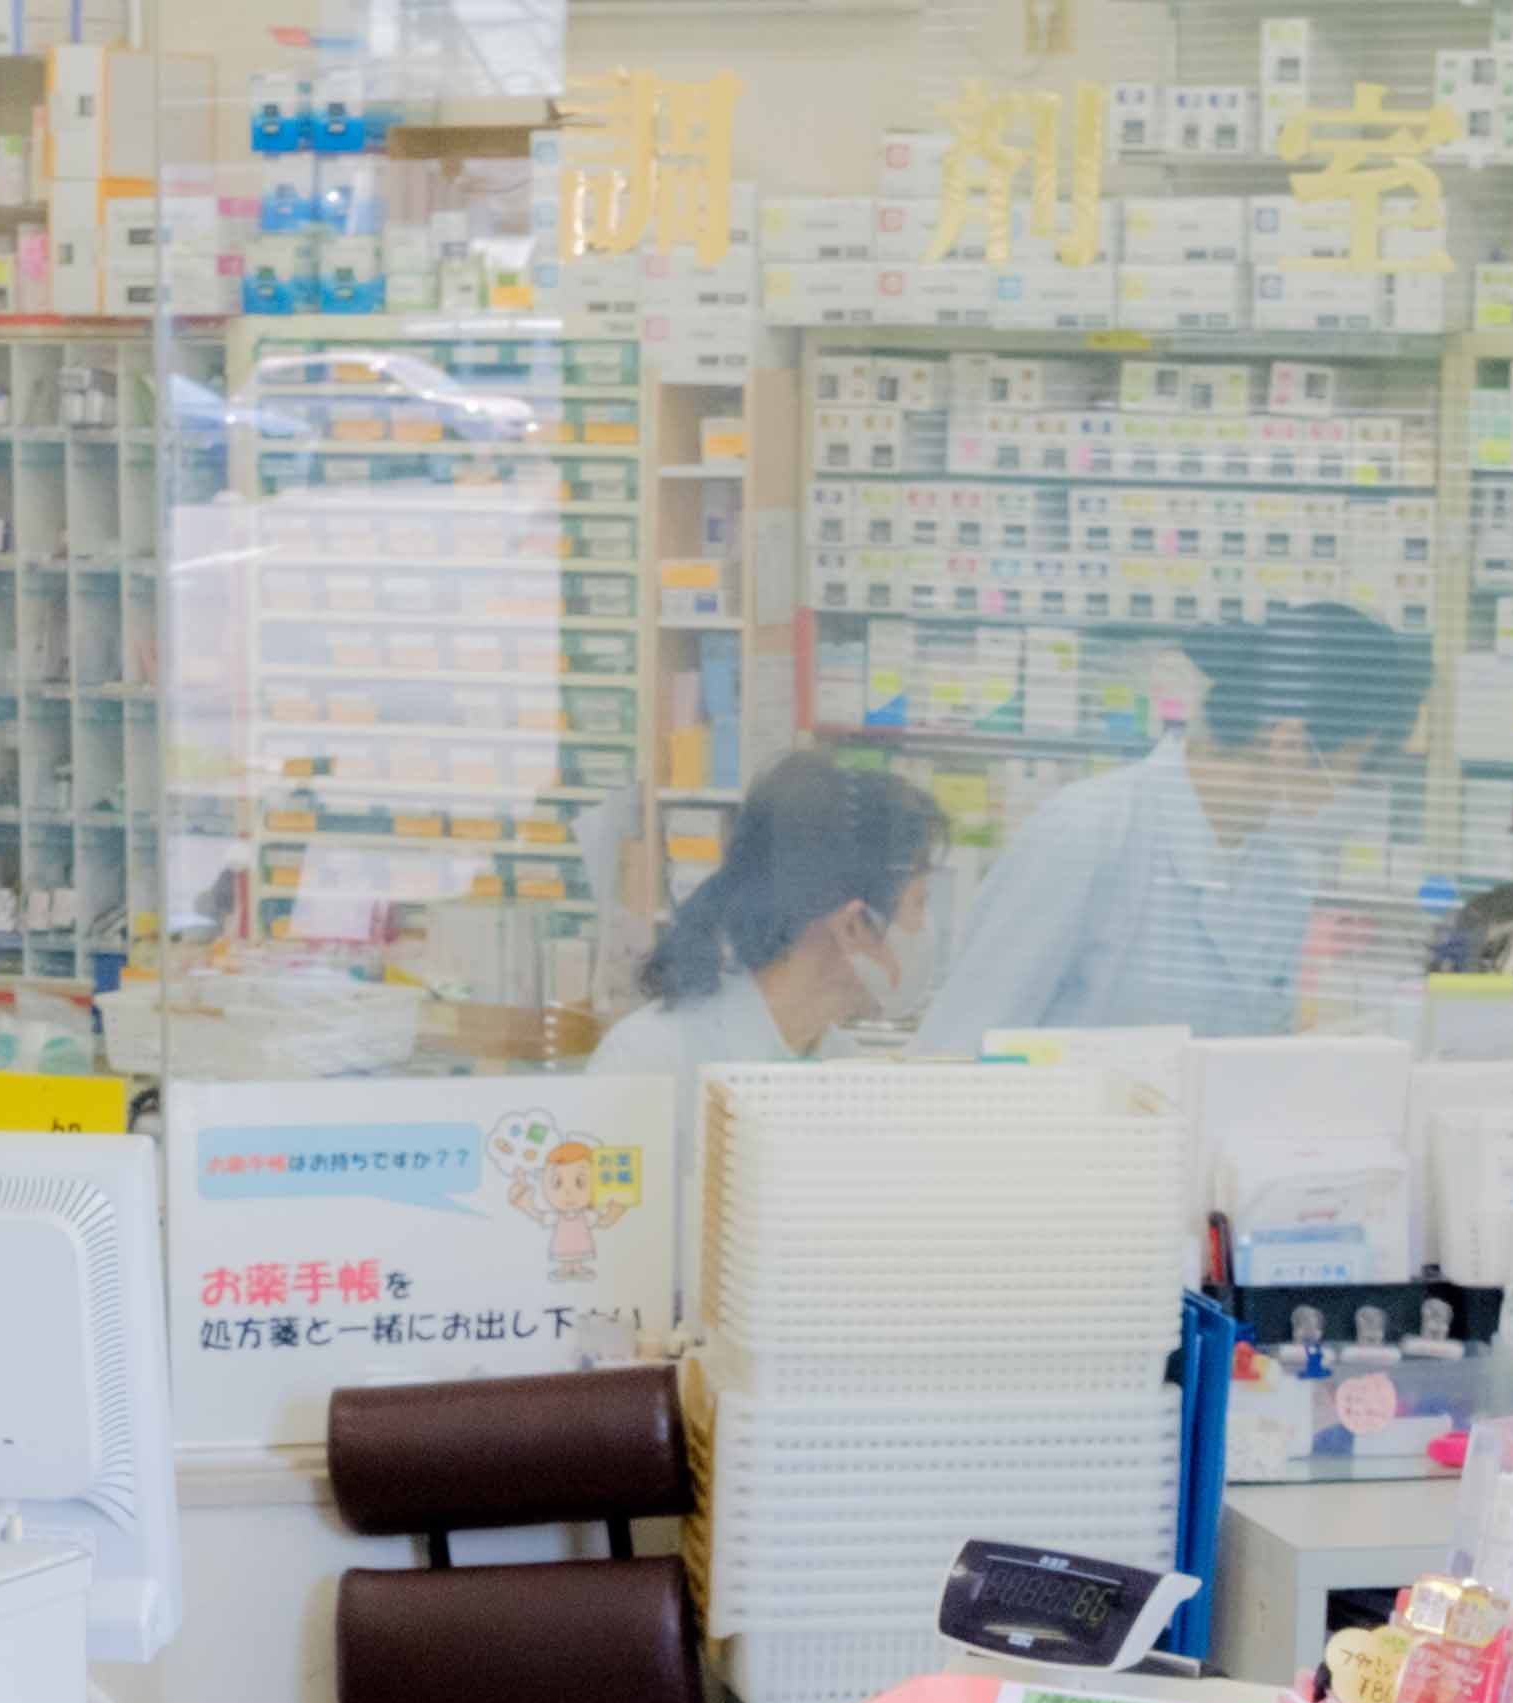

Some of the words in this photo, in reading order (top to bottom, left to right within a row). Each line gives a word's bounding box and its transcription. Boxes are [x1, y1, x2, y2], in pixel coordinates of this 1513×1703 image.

[201, 1256, 413, 1307] お薬手帳を
